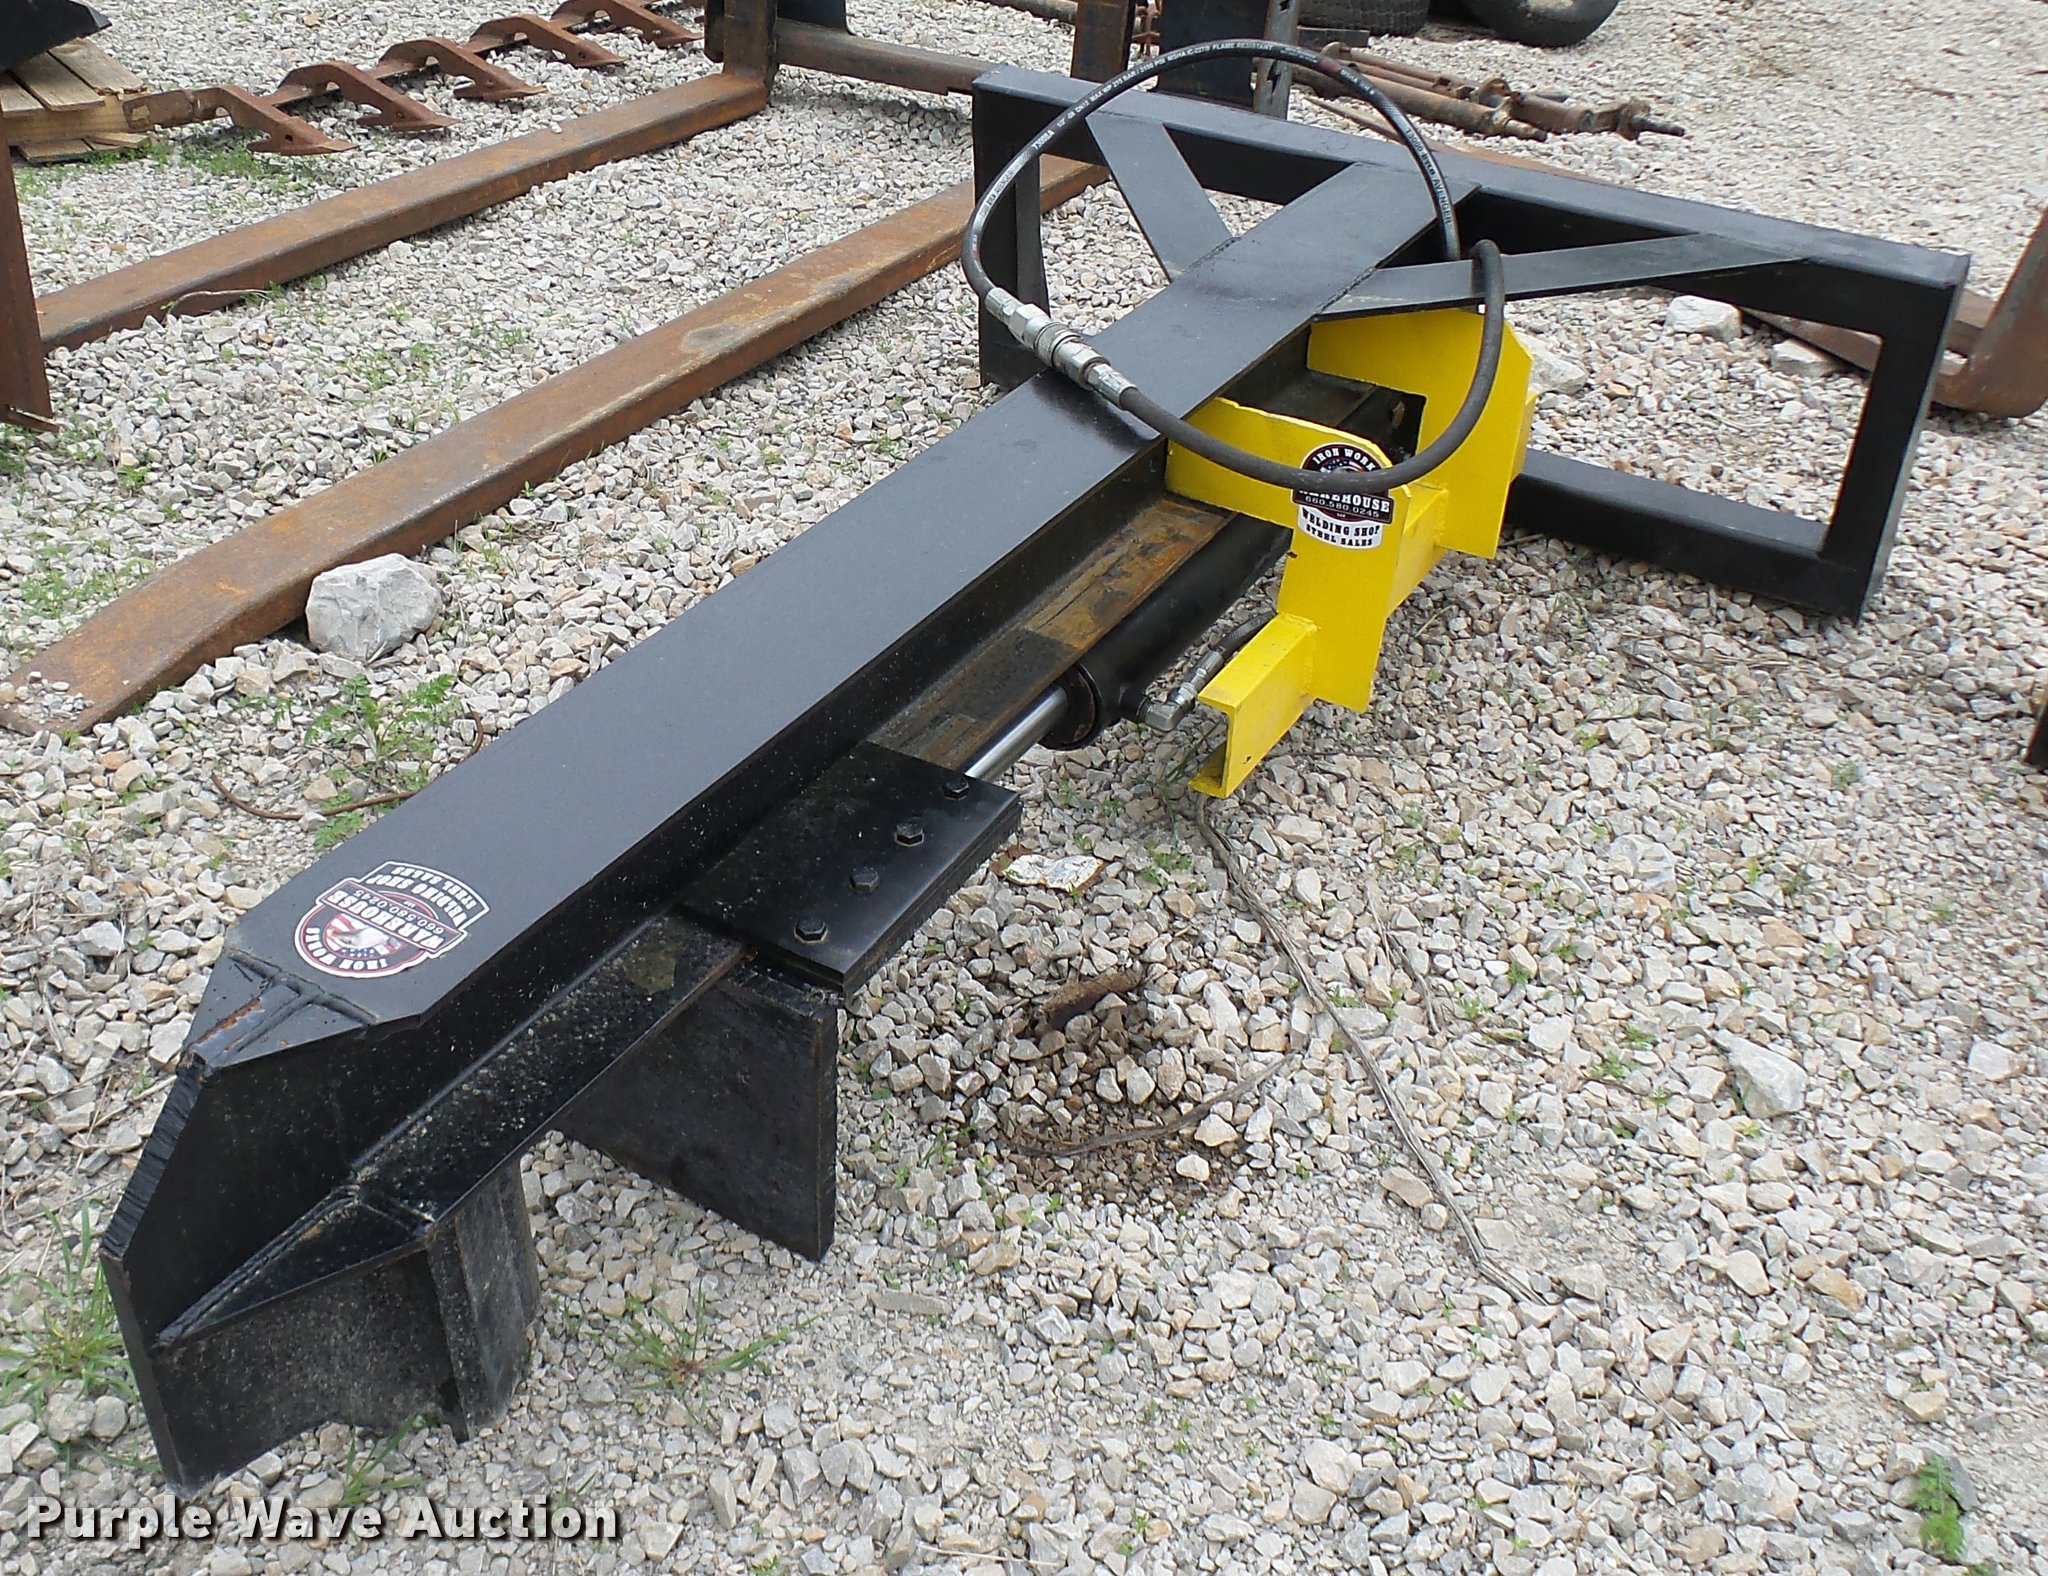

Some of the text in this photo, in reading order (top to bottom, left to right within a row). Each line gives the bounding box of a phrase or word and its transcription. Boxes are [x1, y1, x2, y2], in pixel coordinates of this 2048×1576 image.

[1212, 42, 1236, 51] FLAME
[1236, 42, 1273, 51] RESISTANT
[1432, 178, 1453, 224] AVENGER
[1312, 447, 1377, 471] IRON WORK
[1302, 507, 1380, 537] WELDING SHOP
[1306, 523, 1373, 547] STEEL SALES
[365, 874, 467, 928] WELDING SHOP
[391, 866, 477, 910] STEEL SALES
[326, 889, 445, 949] WAREHOUSE
[353, 889, 444, 934] 660.580.0245
[305, 926, 388, 971] IRON WORKS
